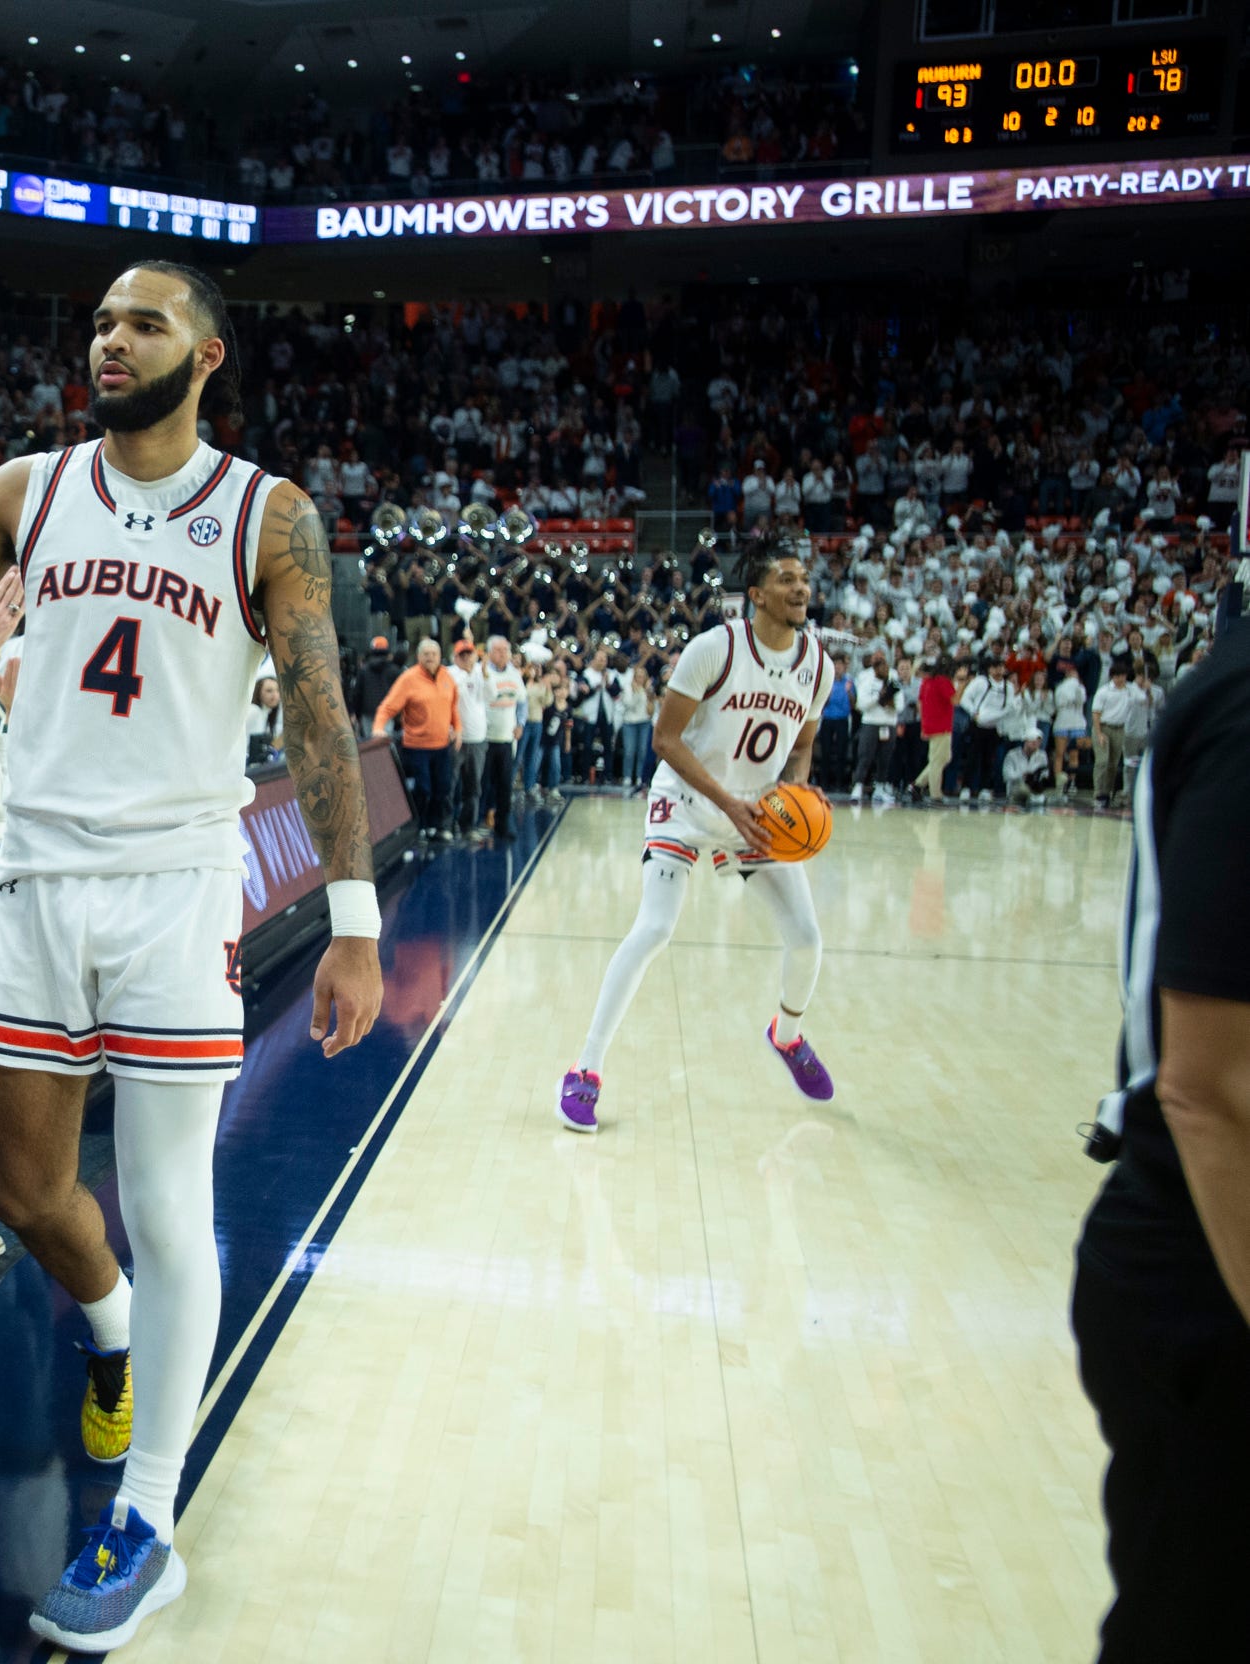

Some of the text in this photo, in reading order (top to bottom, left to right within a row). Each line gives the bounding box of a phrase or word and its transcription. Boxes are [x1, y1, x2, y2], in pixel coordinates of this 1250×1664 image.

[1152, 48, 1178, 65] LSU
[918, 63, 982, 84] AUBURN
[1153, 67, 1182, 92] 78
[937, 83, 968, 108] 93
[1003, 110, 1021, 131] 10
[1045, 106, 1058, 127] 2
[1076, 105, 1095, 126] 10
[624, 184, 805, 227] VICTORY
[820, 175, 976, 217] GRILLE
[1016, 166, 1223, 202] PARTY-READY
[147, 209, 160, 232] 2
[190, 516, 220, 546] SEC
[36, 558, 223, 638] AUBURN
[79, 615, 144, 718] 4
[720, 692, 807, 724] AUBURN
[732, 717, 779, 764] 10
